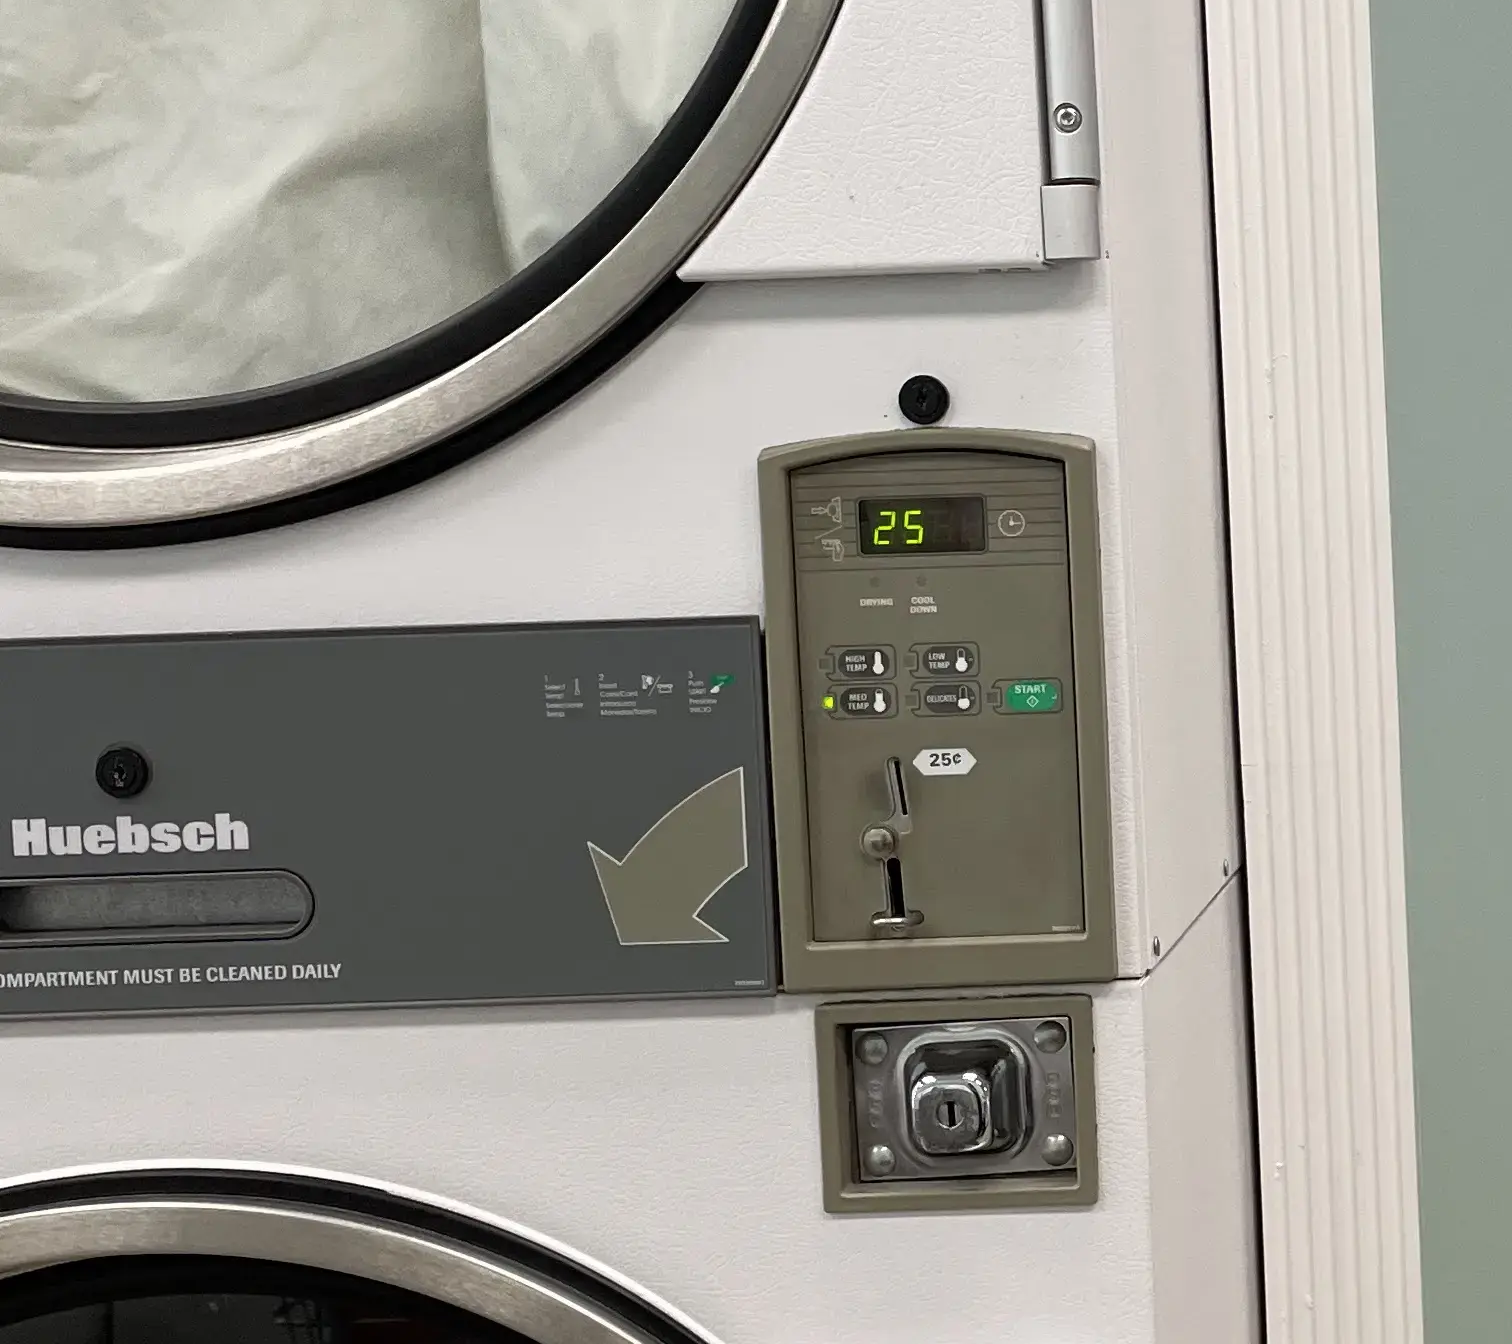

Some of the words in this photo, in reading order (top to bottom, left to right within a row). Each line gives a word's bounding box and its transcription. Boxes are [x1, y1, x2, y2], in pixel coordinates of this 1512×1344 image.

[872, 509, 925, 545] 25
[859, 597, 894, 607] DRYING
[910, 596, 936, 605] COOL
[909, 605, 938, 614] DOWN
[845, 655, 866, 664] HIGH
[928, 652, 946, 662] LOW
[846, 663, 868, 673] TEMP
[928, 660, 951, 670] TEMP
[1014, 683, 1047, 695] START
[849, 693, 868, 702] MED
[848, 701, 870, 711] TEMP
[928, 752, 963, 767] 25¢
[11, 812, 251, 857] Huebsch
[123, 968, 174, 986] MUST
[179, 967, 202, 983] BE
[205, 964, 288, 983] CLEANED
[292, 963, 342, 980] DAILY
